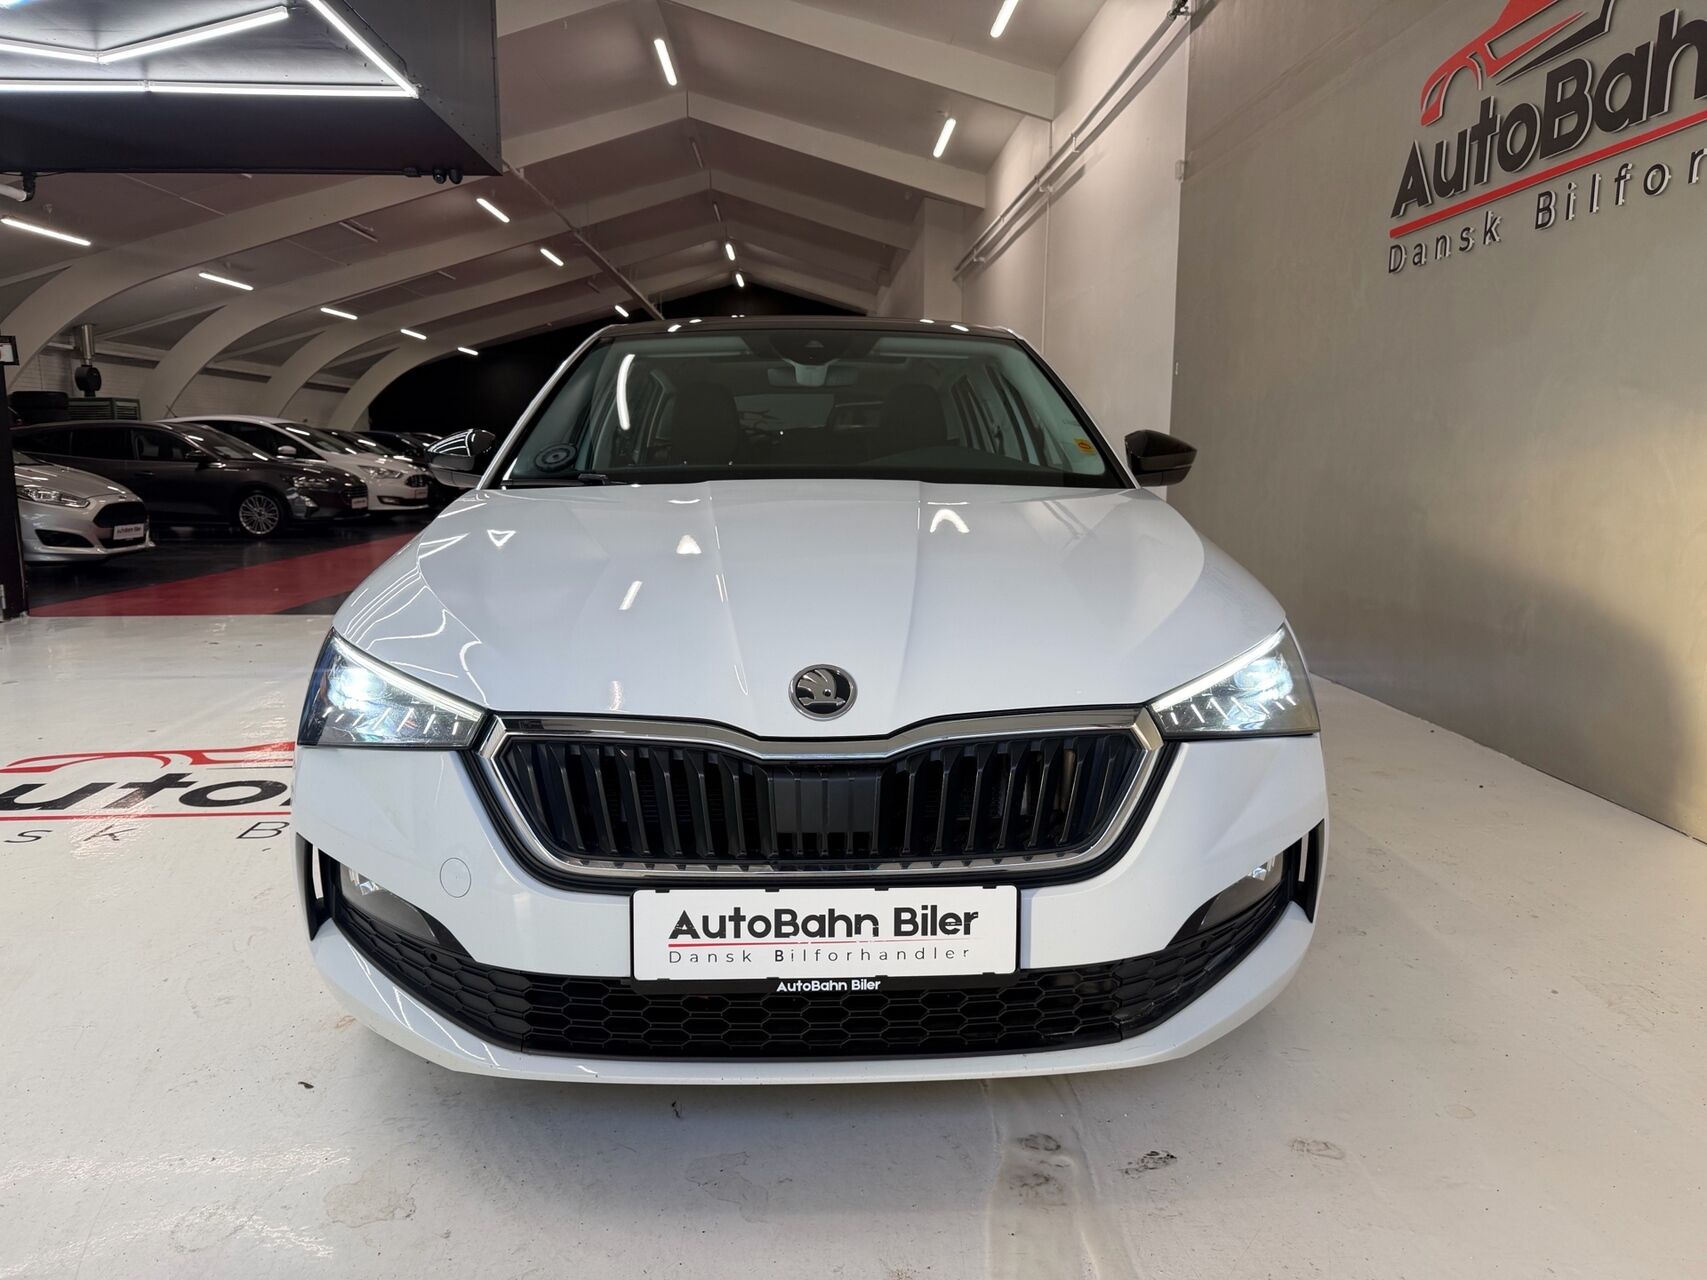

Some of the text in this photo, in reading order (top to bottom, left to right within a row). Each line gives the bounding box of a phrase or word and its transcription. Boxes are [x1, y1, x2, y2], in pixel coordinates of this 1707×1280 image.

[1390, 8, 1707, 219] AutoBah
[1388, 210, 1502, 274] Dansk
[0, 773, 291, 810] uto
[668, 904, 979, 940] AutoBahn Biler
[668, 946, 969, 964] Dansk Bilforhandler
[776, 978, 881, 992] AutoBahn Biler
